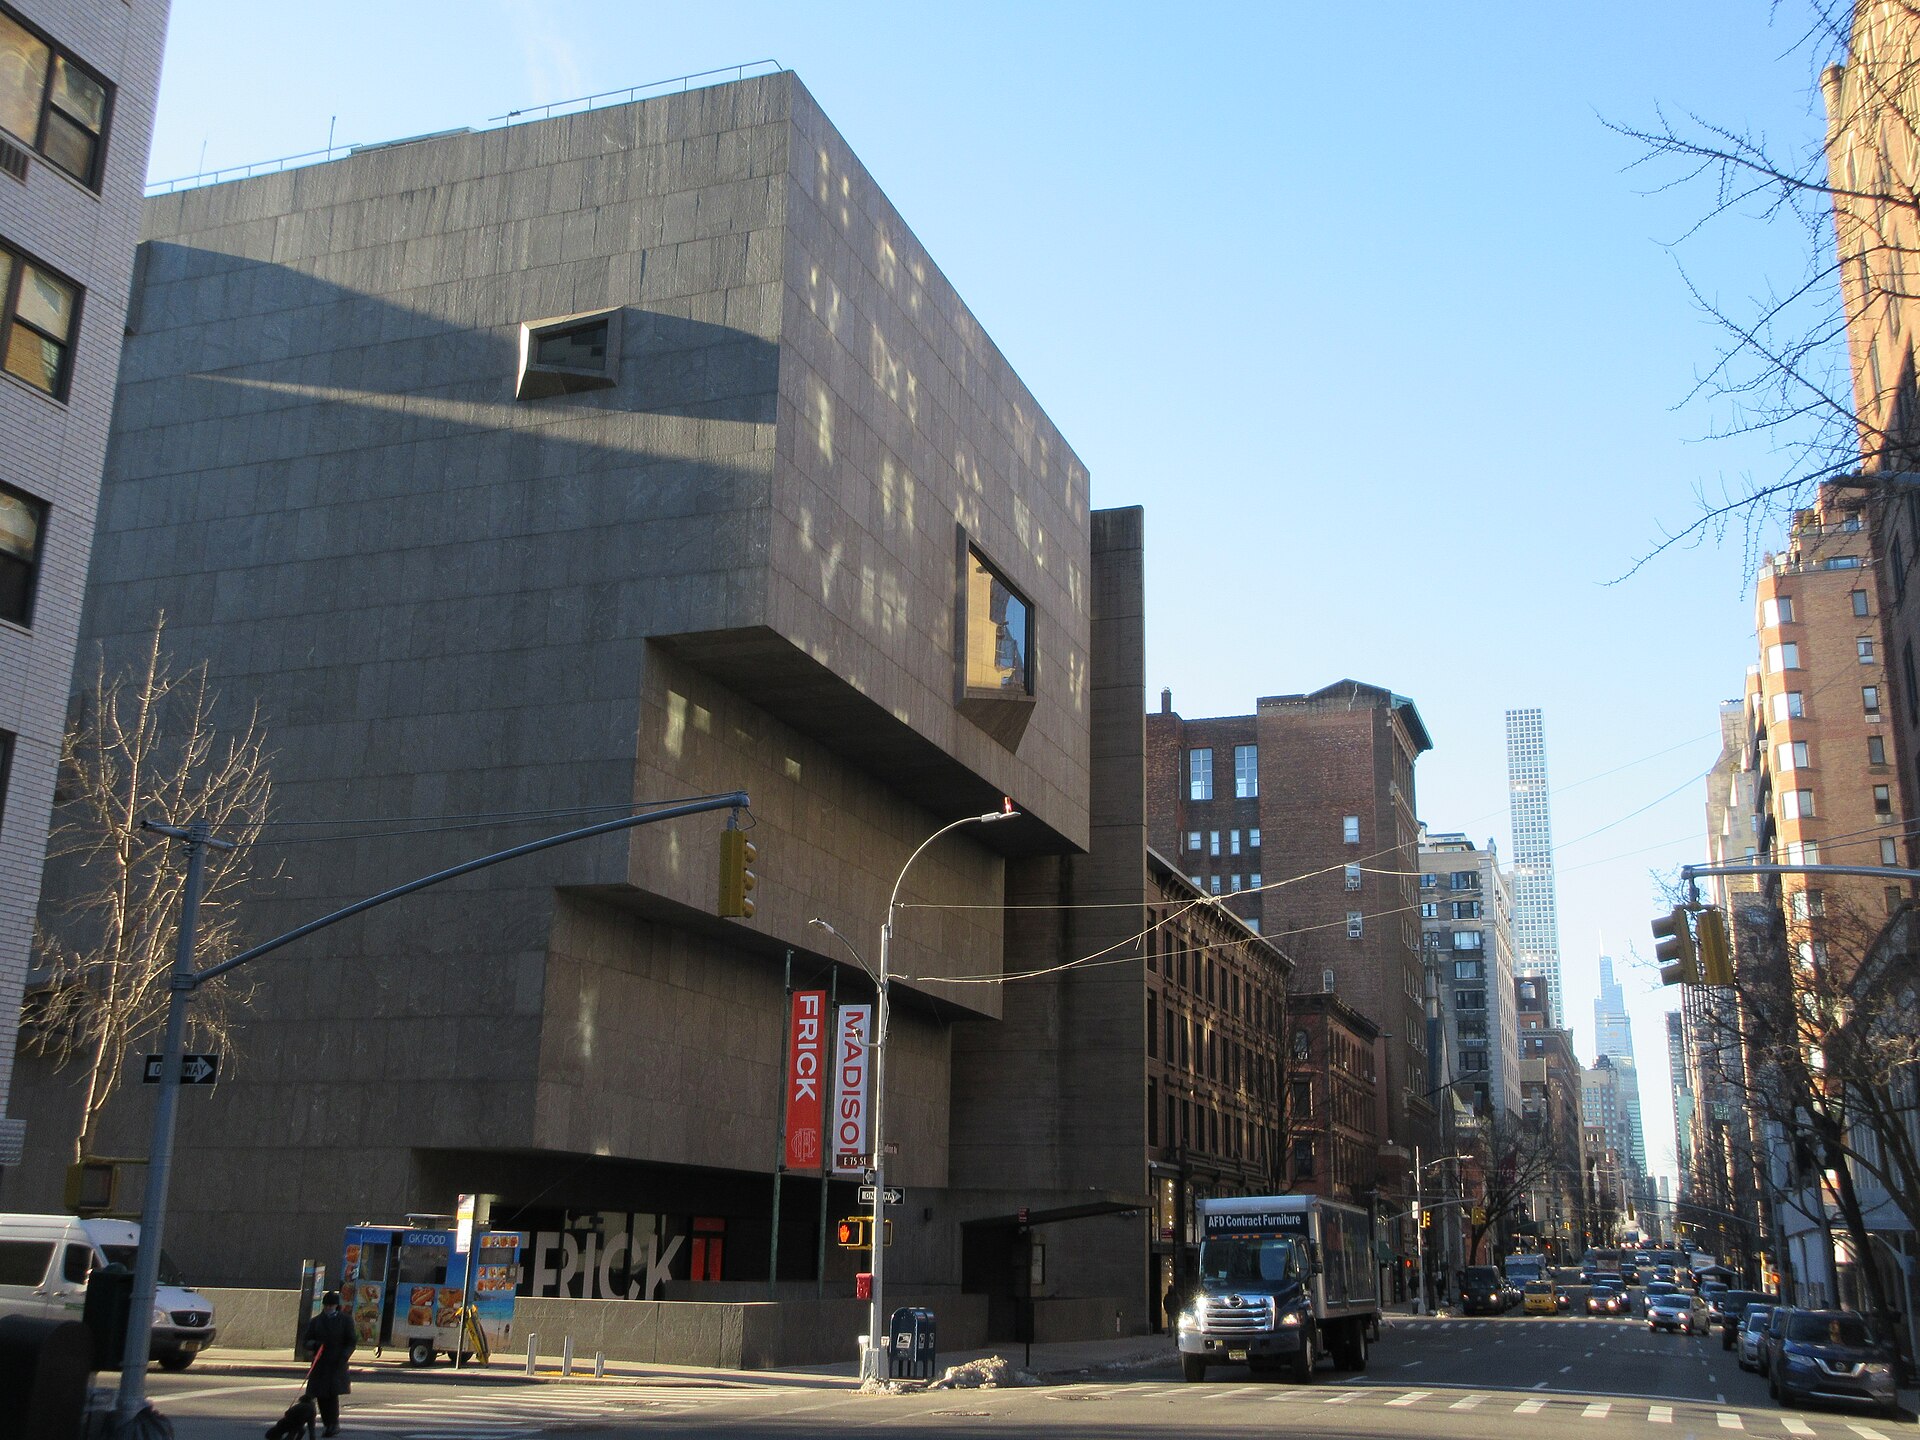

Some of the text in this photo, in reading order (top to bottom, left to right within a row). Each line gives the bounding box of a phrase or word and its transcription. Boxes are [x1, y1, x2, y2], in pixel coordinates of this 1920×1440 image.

[796, 995, 819, 1102] FRICK
[185, 1064, 206, 1075] WAY
[843, 1157, 848, 1165] E
[1208, 1214, 1300, 1228] AFD Contract Furniture
[409, 1233, 446, 1245] GK FOOD
[532, 1231, 686, 1301] FRICK
